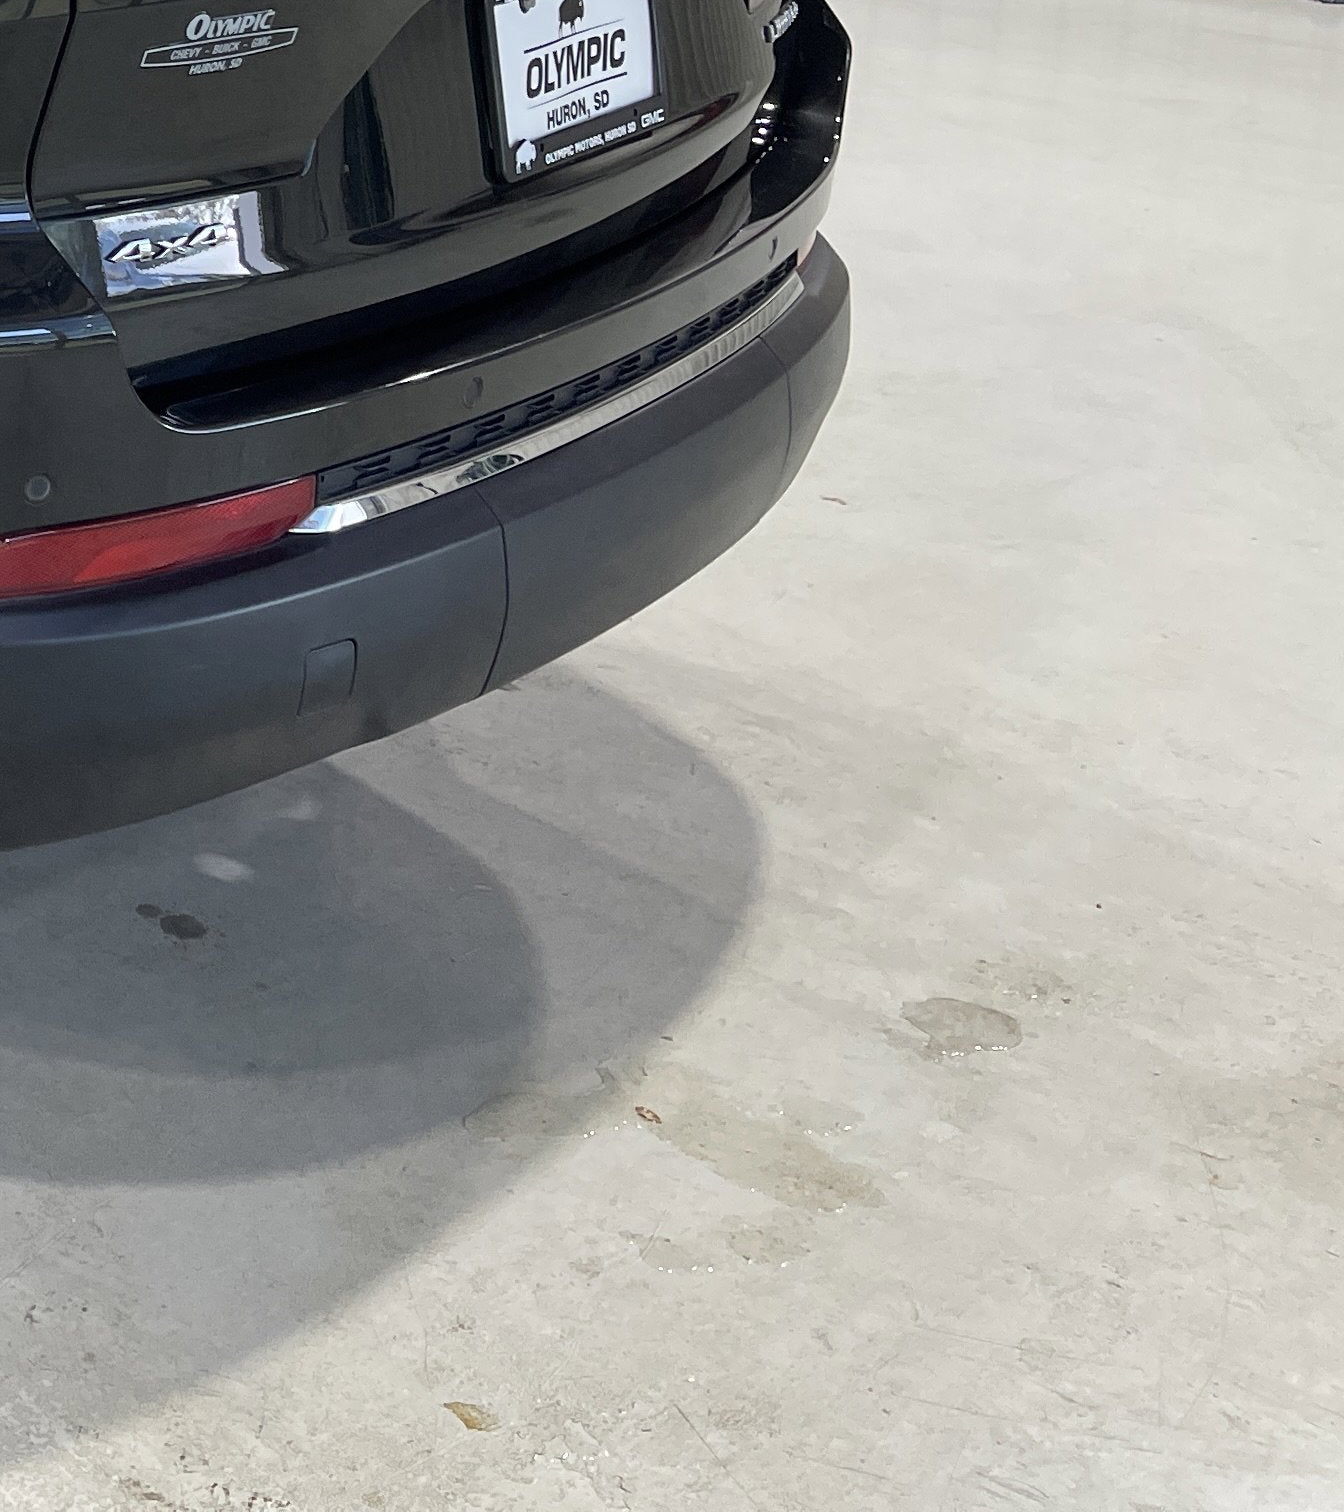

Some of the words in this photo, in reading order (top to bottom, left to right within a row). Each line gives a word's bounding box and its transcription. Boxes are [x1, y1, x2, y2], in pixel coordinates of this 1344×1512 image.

[170, 47, 202, 61] CHEVY
[212, 41, 242, 55] BUICK
[526, 28, 627, 100] OLYMPIC
[546, 96, 591, 131] HURON,
[593, 89, 610, 111] SD
[640, 108, 665, 128] GMC
[544, 144, 575, 165] OLYMPIC
